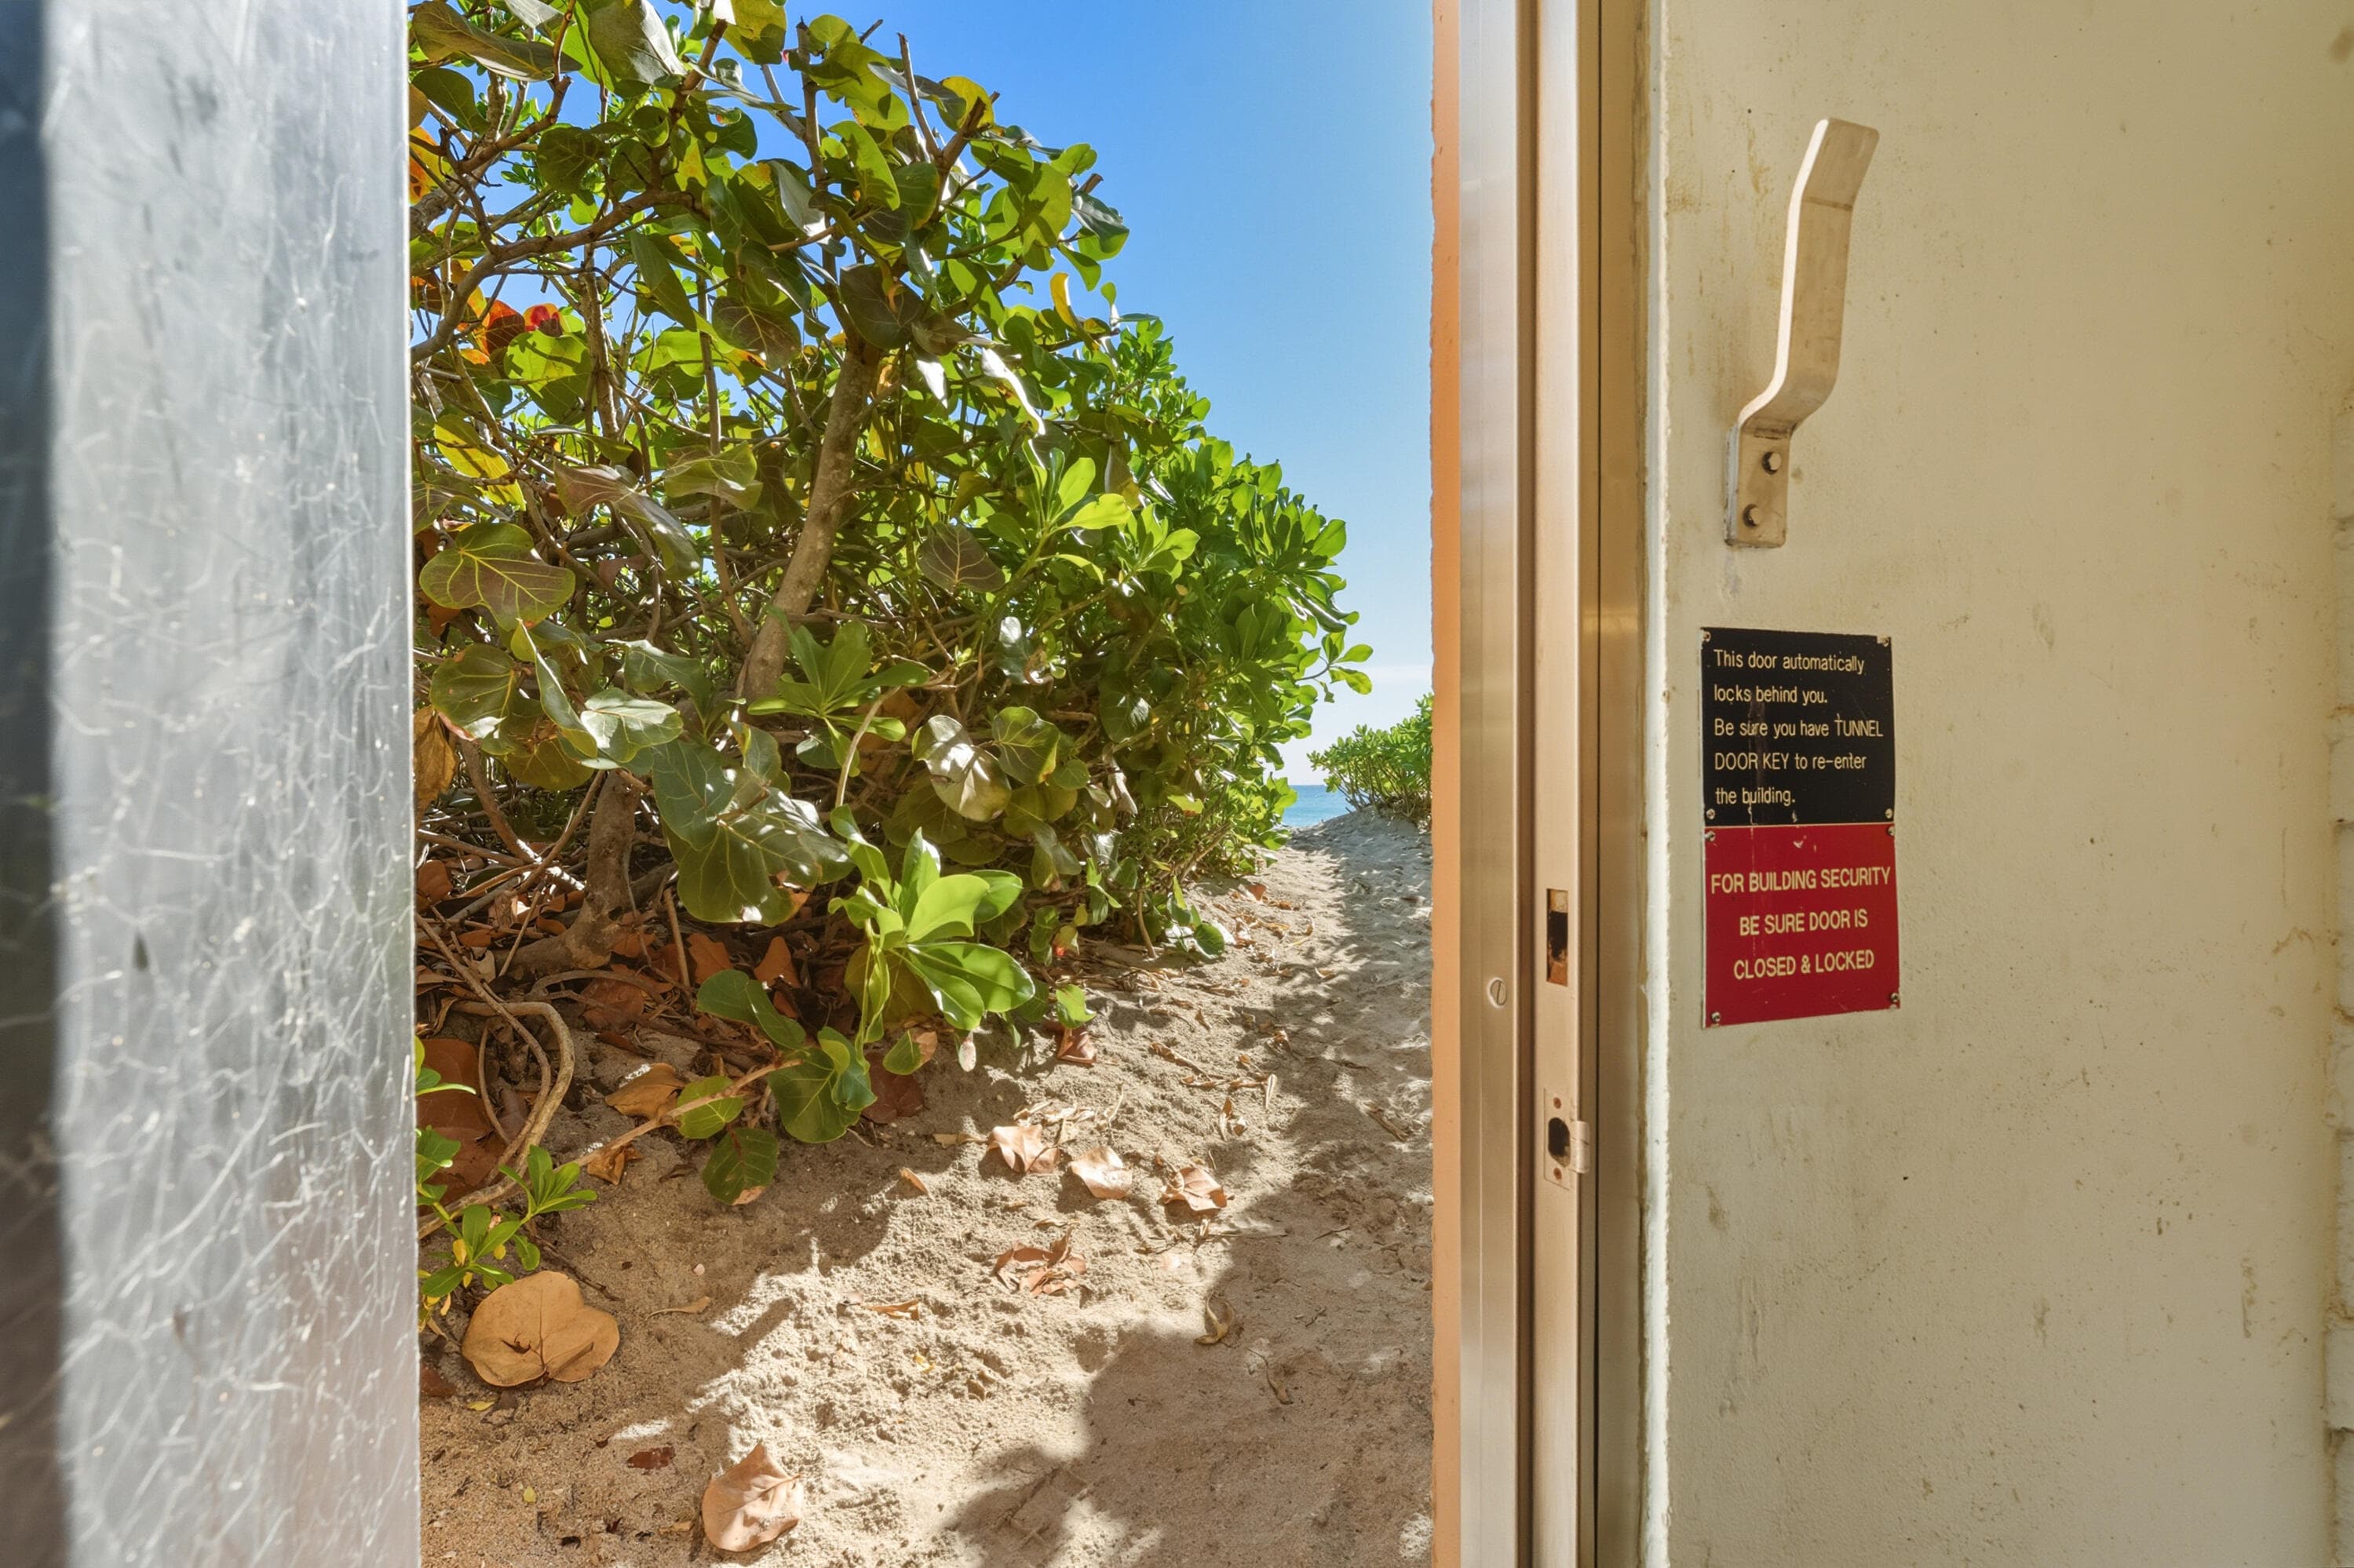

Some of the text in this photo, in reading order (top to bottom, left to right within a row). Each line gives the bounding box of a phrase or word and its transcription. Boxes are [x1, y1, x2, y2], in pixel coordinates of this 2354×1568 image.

[1714, 649, 1864, 674] This door automatically
[1714, 684, 1827, 706] locks behind you.
[1714, 719, 1883, 739] Be sure you have TUNNEL
[1714, 753, 1867, 770] DOOR KEY to re-enter
[1716, 787, 1795, 806] the building.
[1711, 866, 1890, 894] FOR BUILDING SECURITY
[1740, 909, 1868, 935] BE SURE DOOR IS
[1734, 949, 1874, 979] CLOSED & LOCKED
